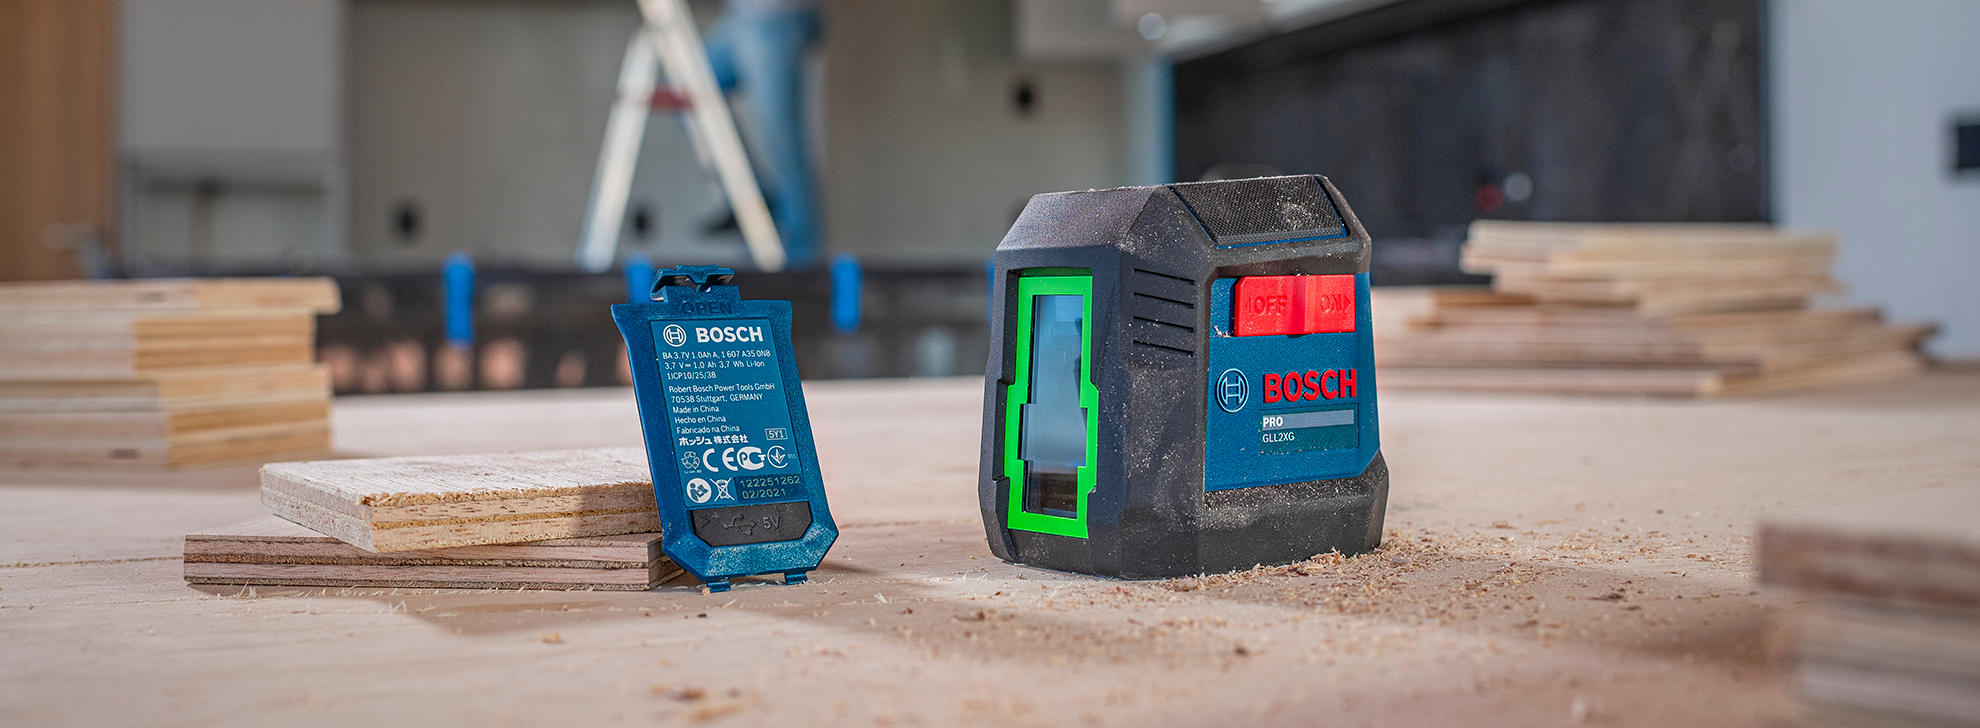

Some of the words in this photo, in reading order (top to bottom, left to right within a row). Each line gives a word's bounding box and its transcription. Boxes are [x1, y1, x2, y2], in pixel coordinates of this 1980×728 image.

[682, 301, 733, 314] OPEN
[1254, 296, 1287, 314] OFF
[1320, 294, 1342, 312] ON
[695, 326, 764, 343] BOSCH
[668, 385, 692, 393] Robert
[692, 384, 714, 392] Bosch
[714, 384, 734, 392] Power
[1264, 369, 1357, 404] BOSCH
[730, 394, 763, 402] GERMANY
[672, 406, 692, 414] Made
[674, 416, 696, 424] Hecho
[1262, 416, 1284, 428] PRO
[676, 426, 710, 434] Fabricado
[769, 430, 784, 438] 5Y1
[714, 434, 748, 444] 株式会社
[1262, 432, 1295, 443] GLL2XG
[740, 476, 800, 488] 122251262
[742, 488, 786, 499] 02/2021
[762, 516, 780, 530] 5V
